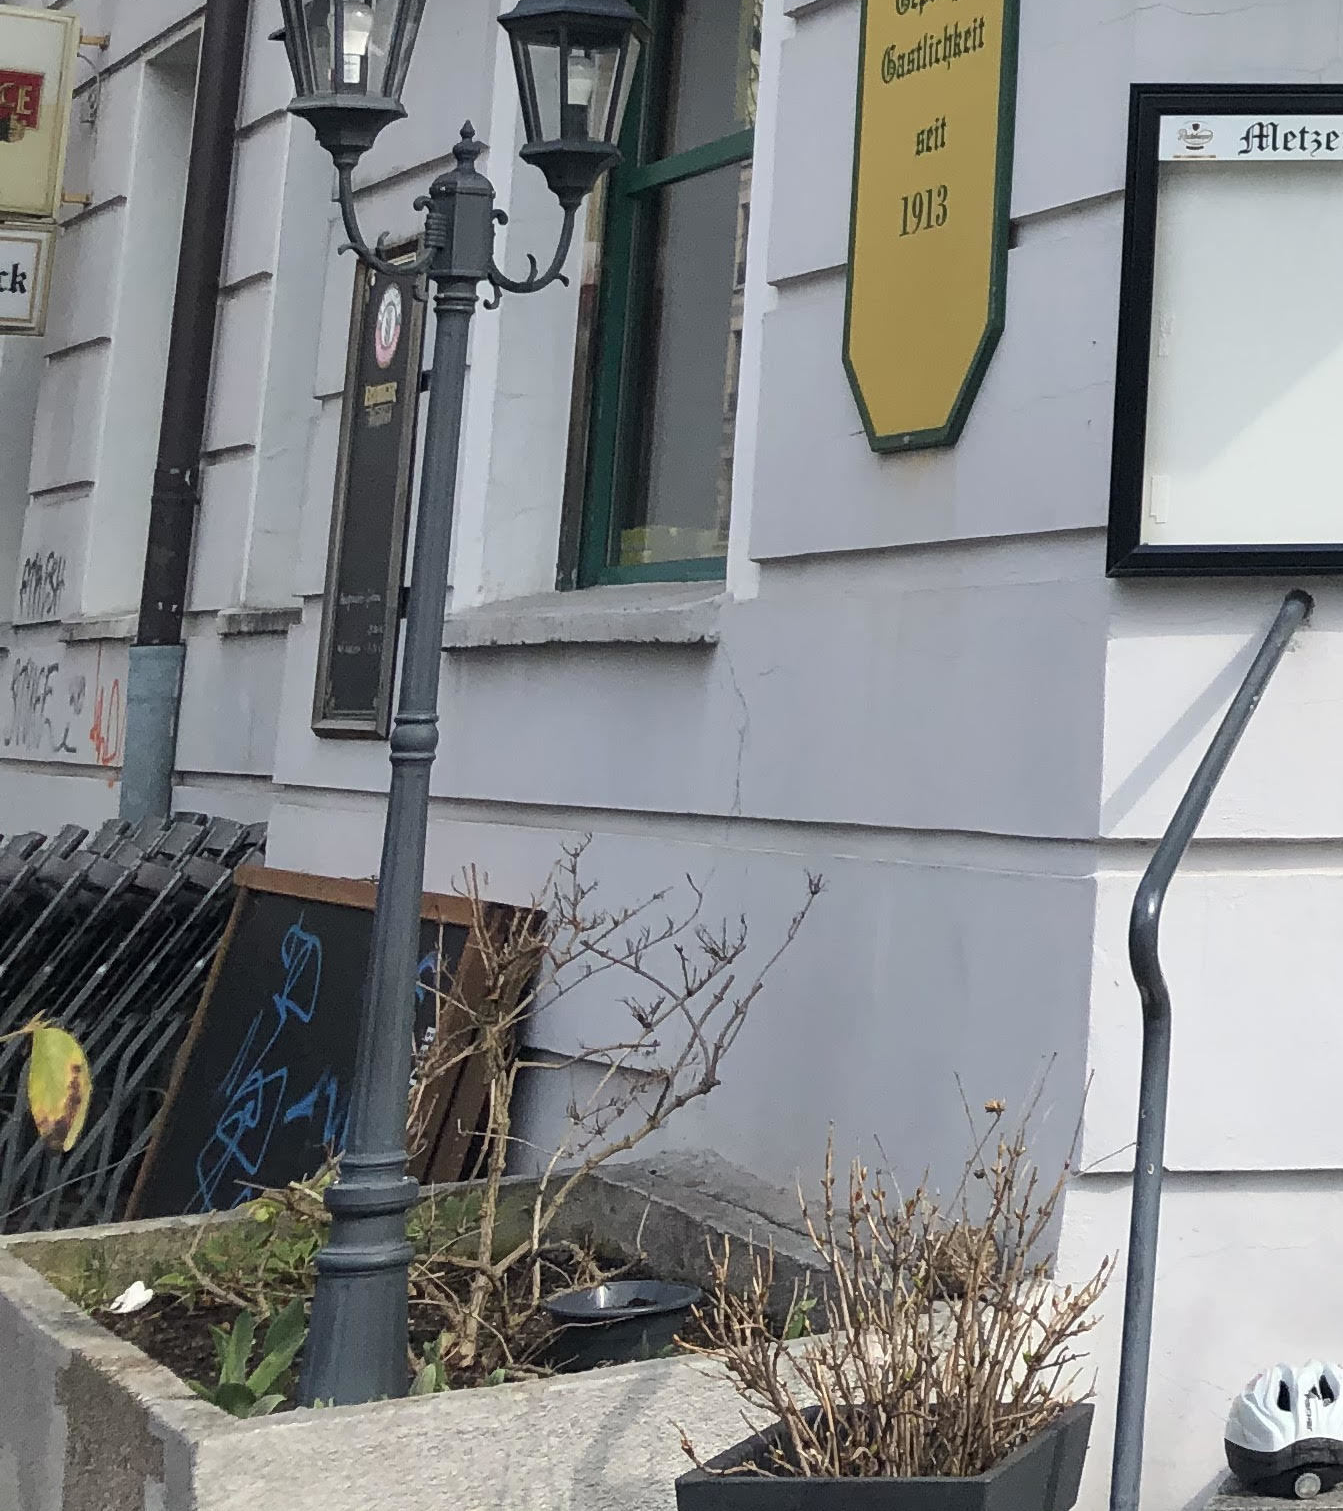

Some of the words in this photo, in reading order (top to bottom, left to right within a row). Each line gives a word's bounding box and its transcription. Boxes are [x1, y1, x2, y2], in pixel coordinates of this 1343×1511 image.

[880, 15, 987, 87] Gastlichkeit
[915, 115, 948, 158] seit
[898, 183, 950, 238] 1913
